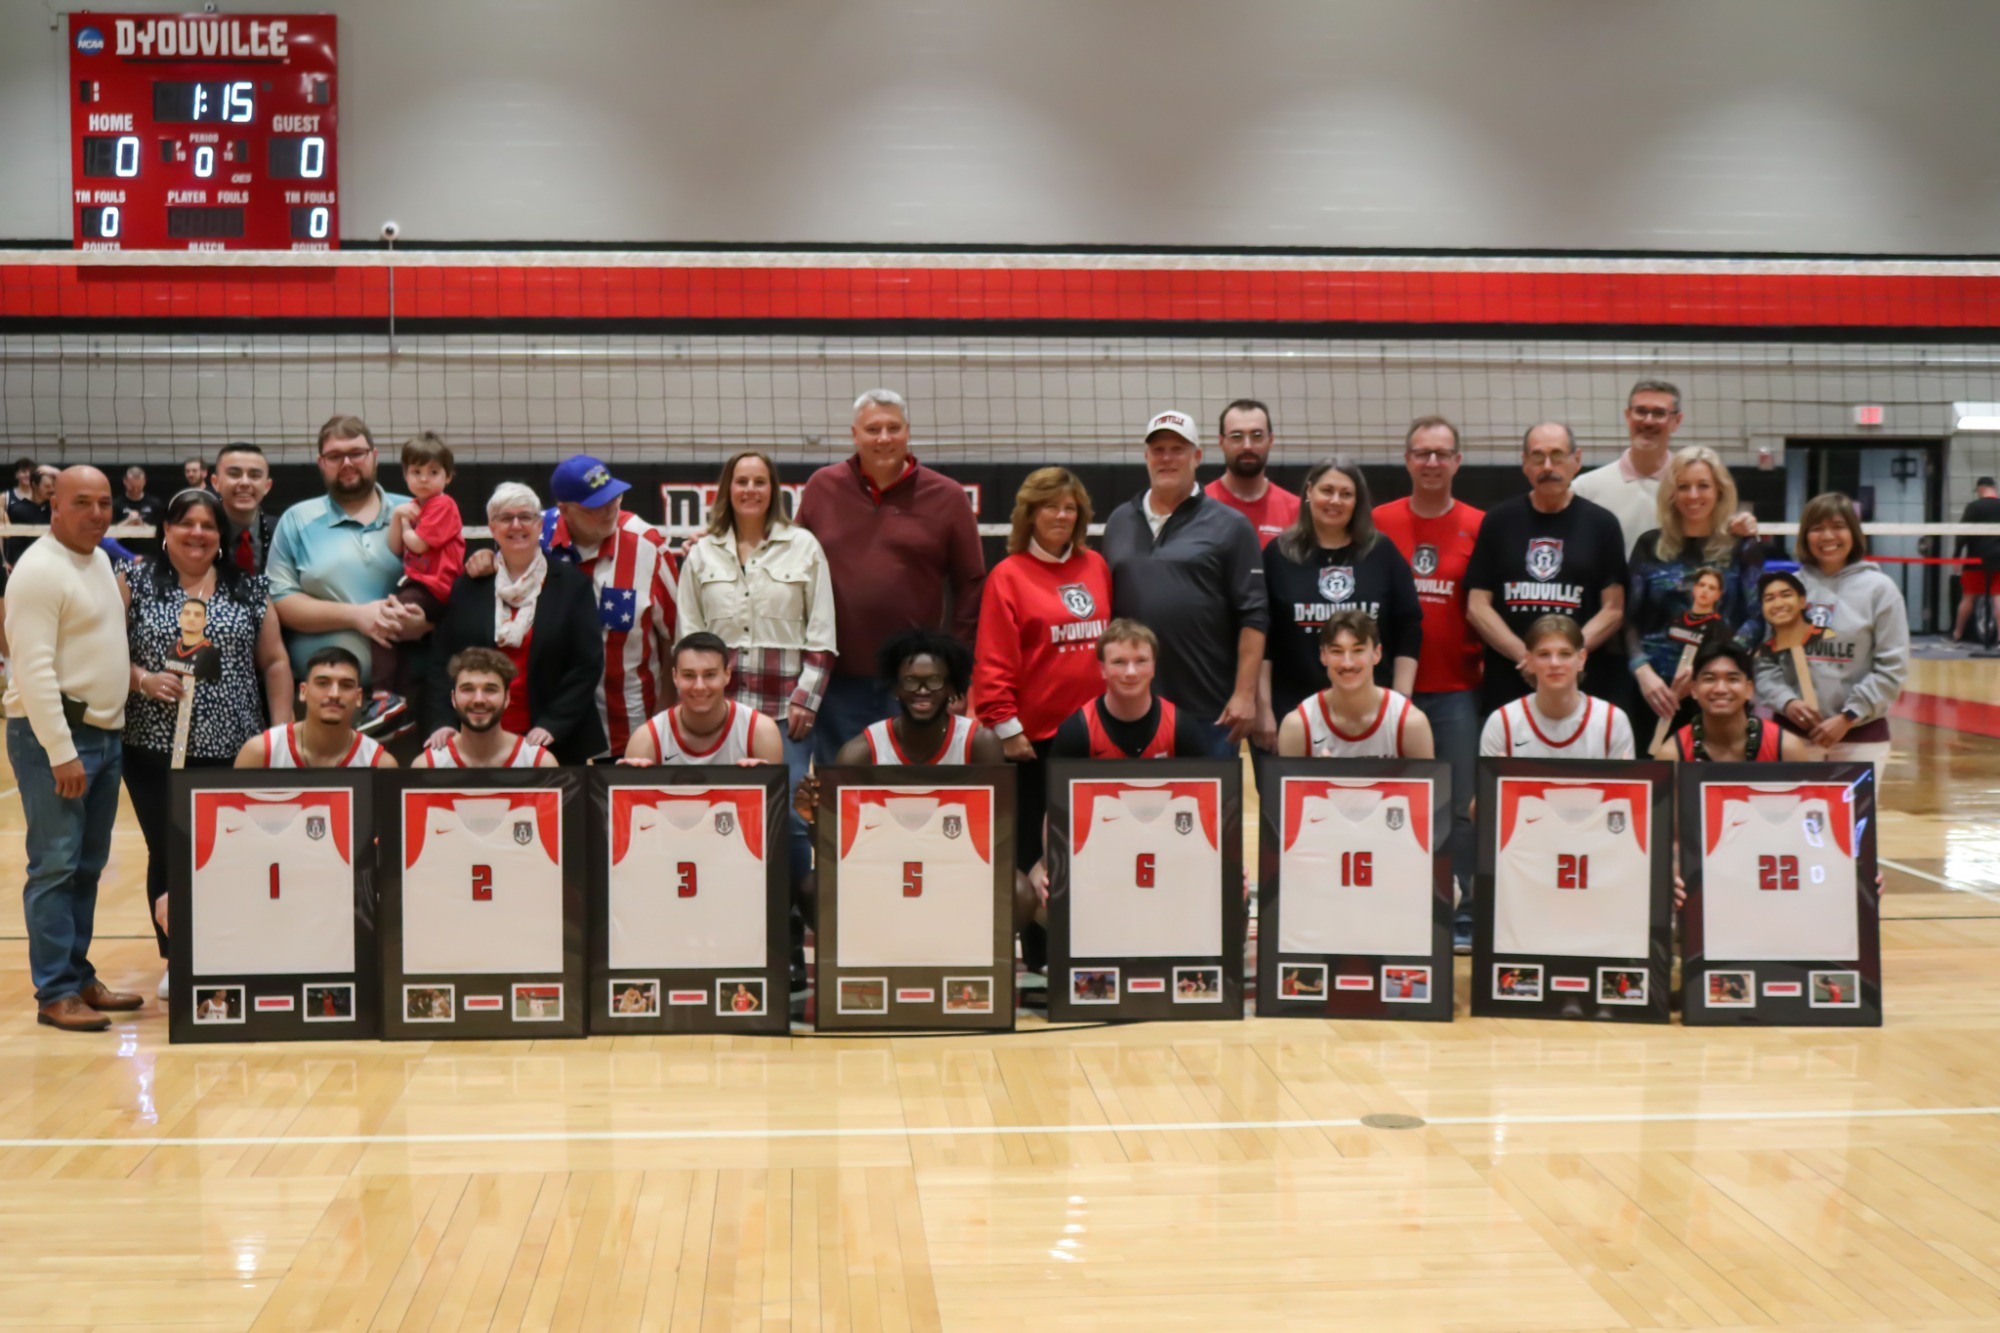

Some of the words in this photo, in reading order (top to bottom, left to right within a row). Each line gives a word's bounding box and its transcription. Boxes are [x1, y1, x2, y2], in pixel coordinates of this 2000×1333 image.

[193, 81, 253, 122] 1:15
[89, 114, 133, 131] HOME
[189, 132, 219, 143] PERIOD
[272, 115, 320, 132] GUEST
[116, 136, 139, 177] 0
[195, 146, 214, 177] 0
[300, 137, 324, 178] 0
[75, 190, 91, 203] TM
[94, 190, 126, 203] FOULS
[168, 190, 206, 203] PLAYER
[217, 190, 249, 203] FOULS
[285, 191, 300, 204] TM
[304, 191, 335, 204] FOULS
[101, 206, 119, 237] 0
[310, 207, 328, 238] 0
[1511, 605, 1573, 615] SAINTS
[269, 863, 280, 899] 1
[472, 864, 493, 901] 2
[677, 862, 697, 898] 3
[904, 862, 923, 898] 5
[1136, 853, 1155, 889] 6
[1342, 851, 1373, 887] 16
[1558, 853, 1588, 889] 21
[1760, 855, 1799, 891] 22
